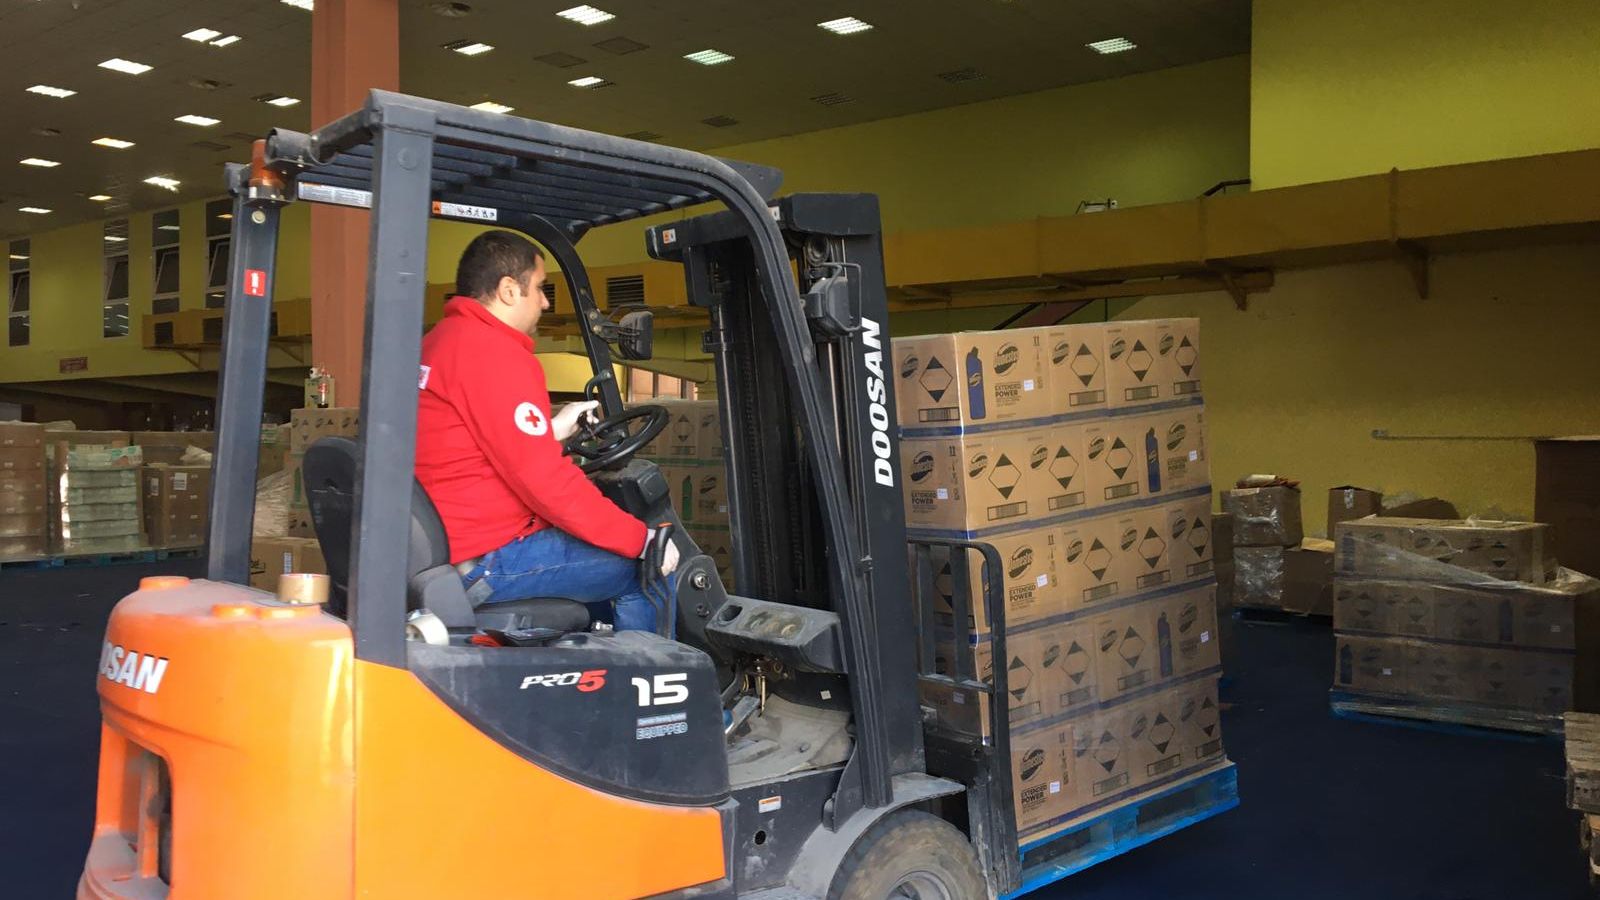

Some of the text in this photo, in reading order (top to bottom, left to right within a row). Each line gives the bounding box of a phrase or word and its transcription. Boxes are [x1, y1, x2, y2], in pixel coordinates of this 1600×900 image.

[861, 317, 894, 488] DOOSAN
[1008, 584, 1036, 596] EXTENDED
[1009, 591, 1033, 602] POWER
[631, 673, 689, 707] 15
[1021, 791, 1044, 804] POWER
